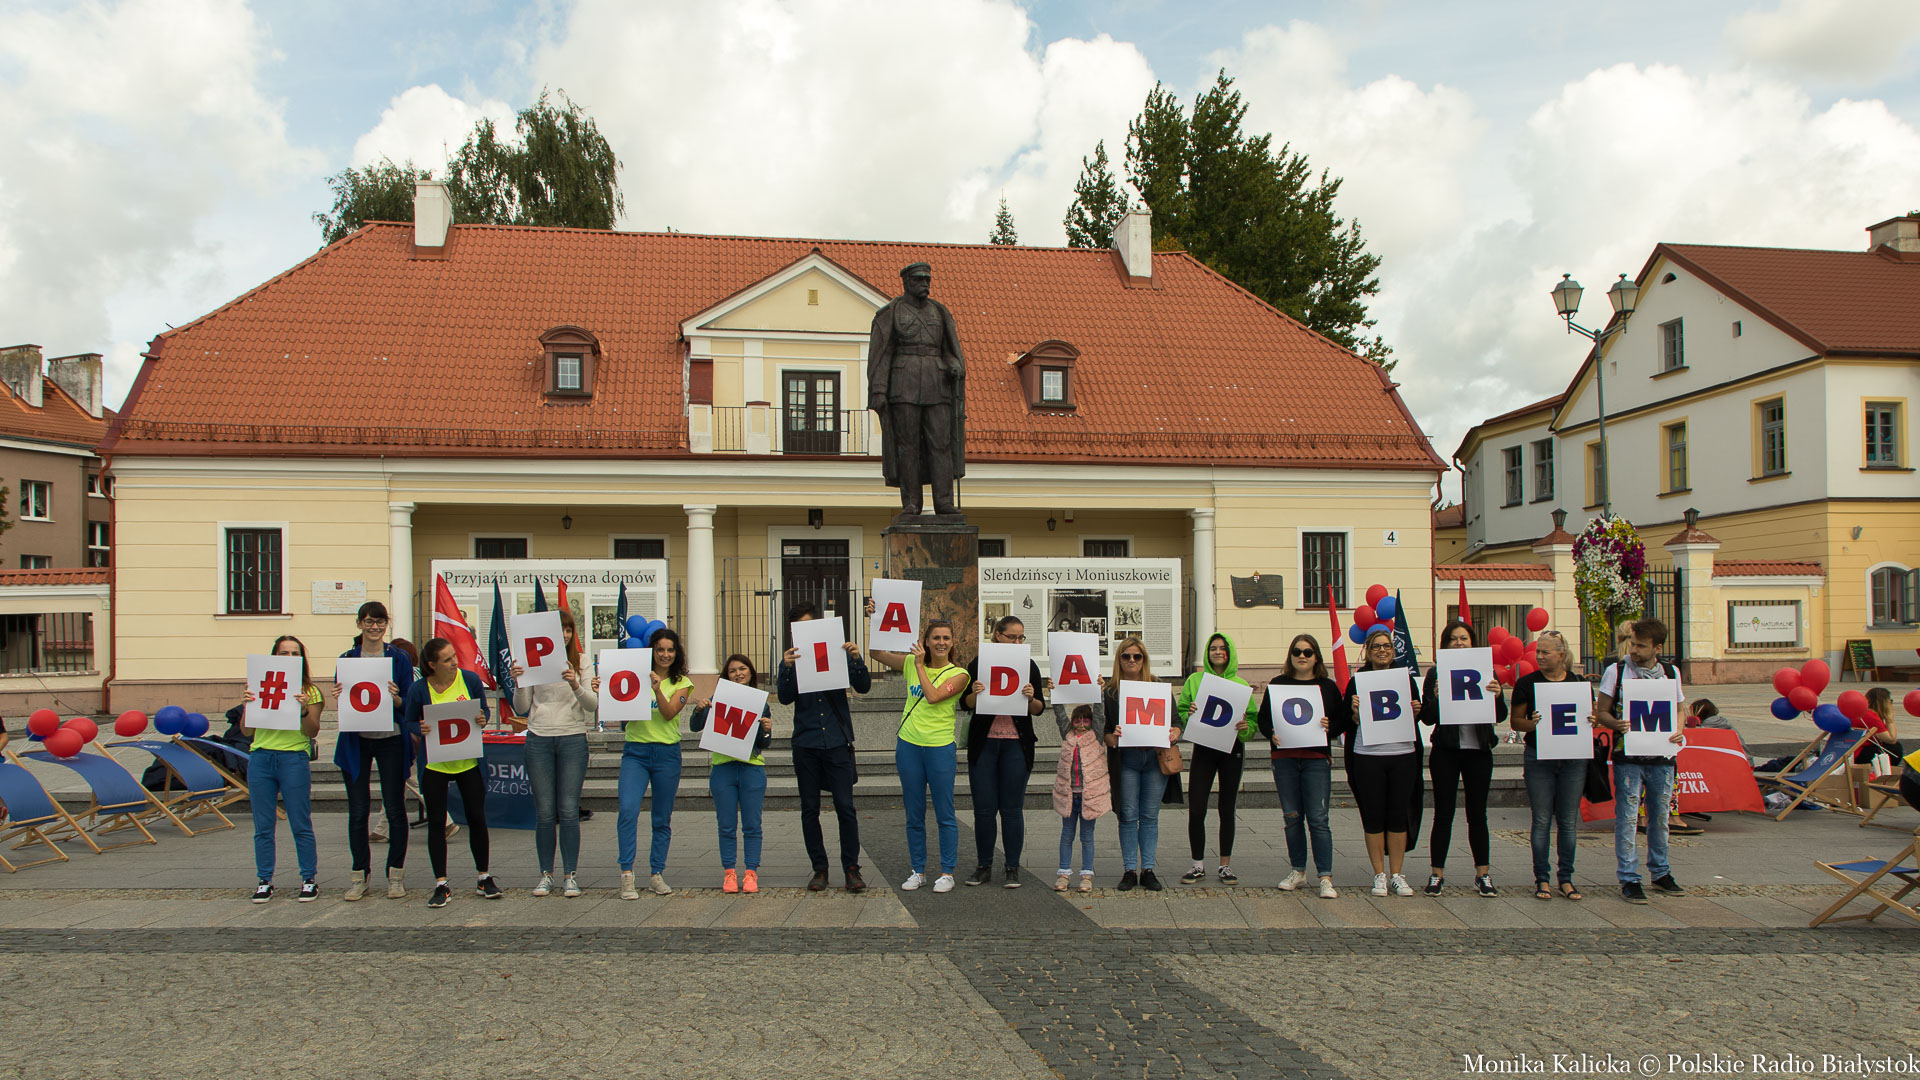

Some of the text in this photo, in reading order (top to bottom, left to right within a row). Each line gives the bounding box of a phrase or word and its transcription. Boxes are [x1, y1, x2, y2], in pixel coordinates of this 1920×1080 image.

[1387, 530, 1396, 543] 4
[443, 570, 656, 588] Przyjaźń artystyczna domów
[983, 568, 1170, 584] Sleńdzińscy i Moniuszkowie
[879, 602, 912, 634] A
[524, 636, 555, 668] P
[813, 641, 830, 673] I
[608, 669, 641, 703] O
[989, 665, 1020, 697] D
[1058, 654, 1092, 686] A
[1449, 668, 1484, 701] R
[260, 671, 289, 710] #
[349, 681, 382, 713] O
[1369, 689, 1402, 722] B
[713, 701, 758, 740] W
[1125, 696, 1166, 727] M
[1199, 694, 1234, 728] D
[1281, 697, 1314, 726] O
[1550, 703, 1578, 736] E
[1631, 700, 1672, 733] M
[438, 718, 472, 746] D
